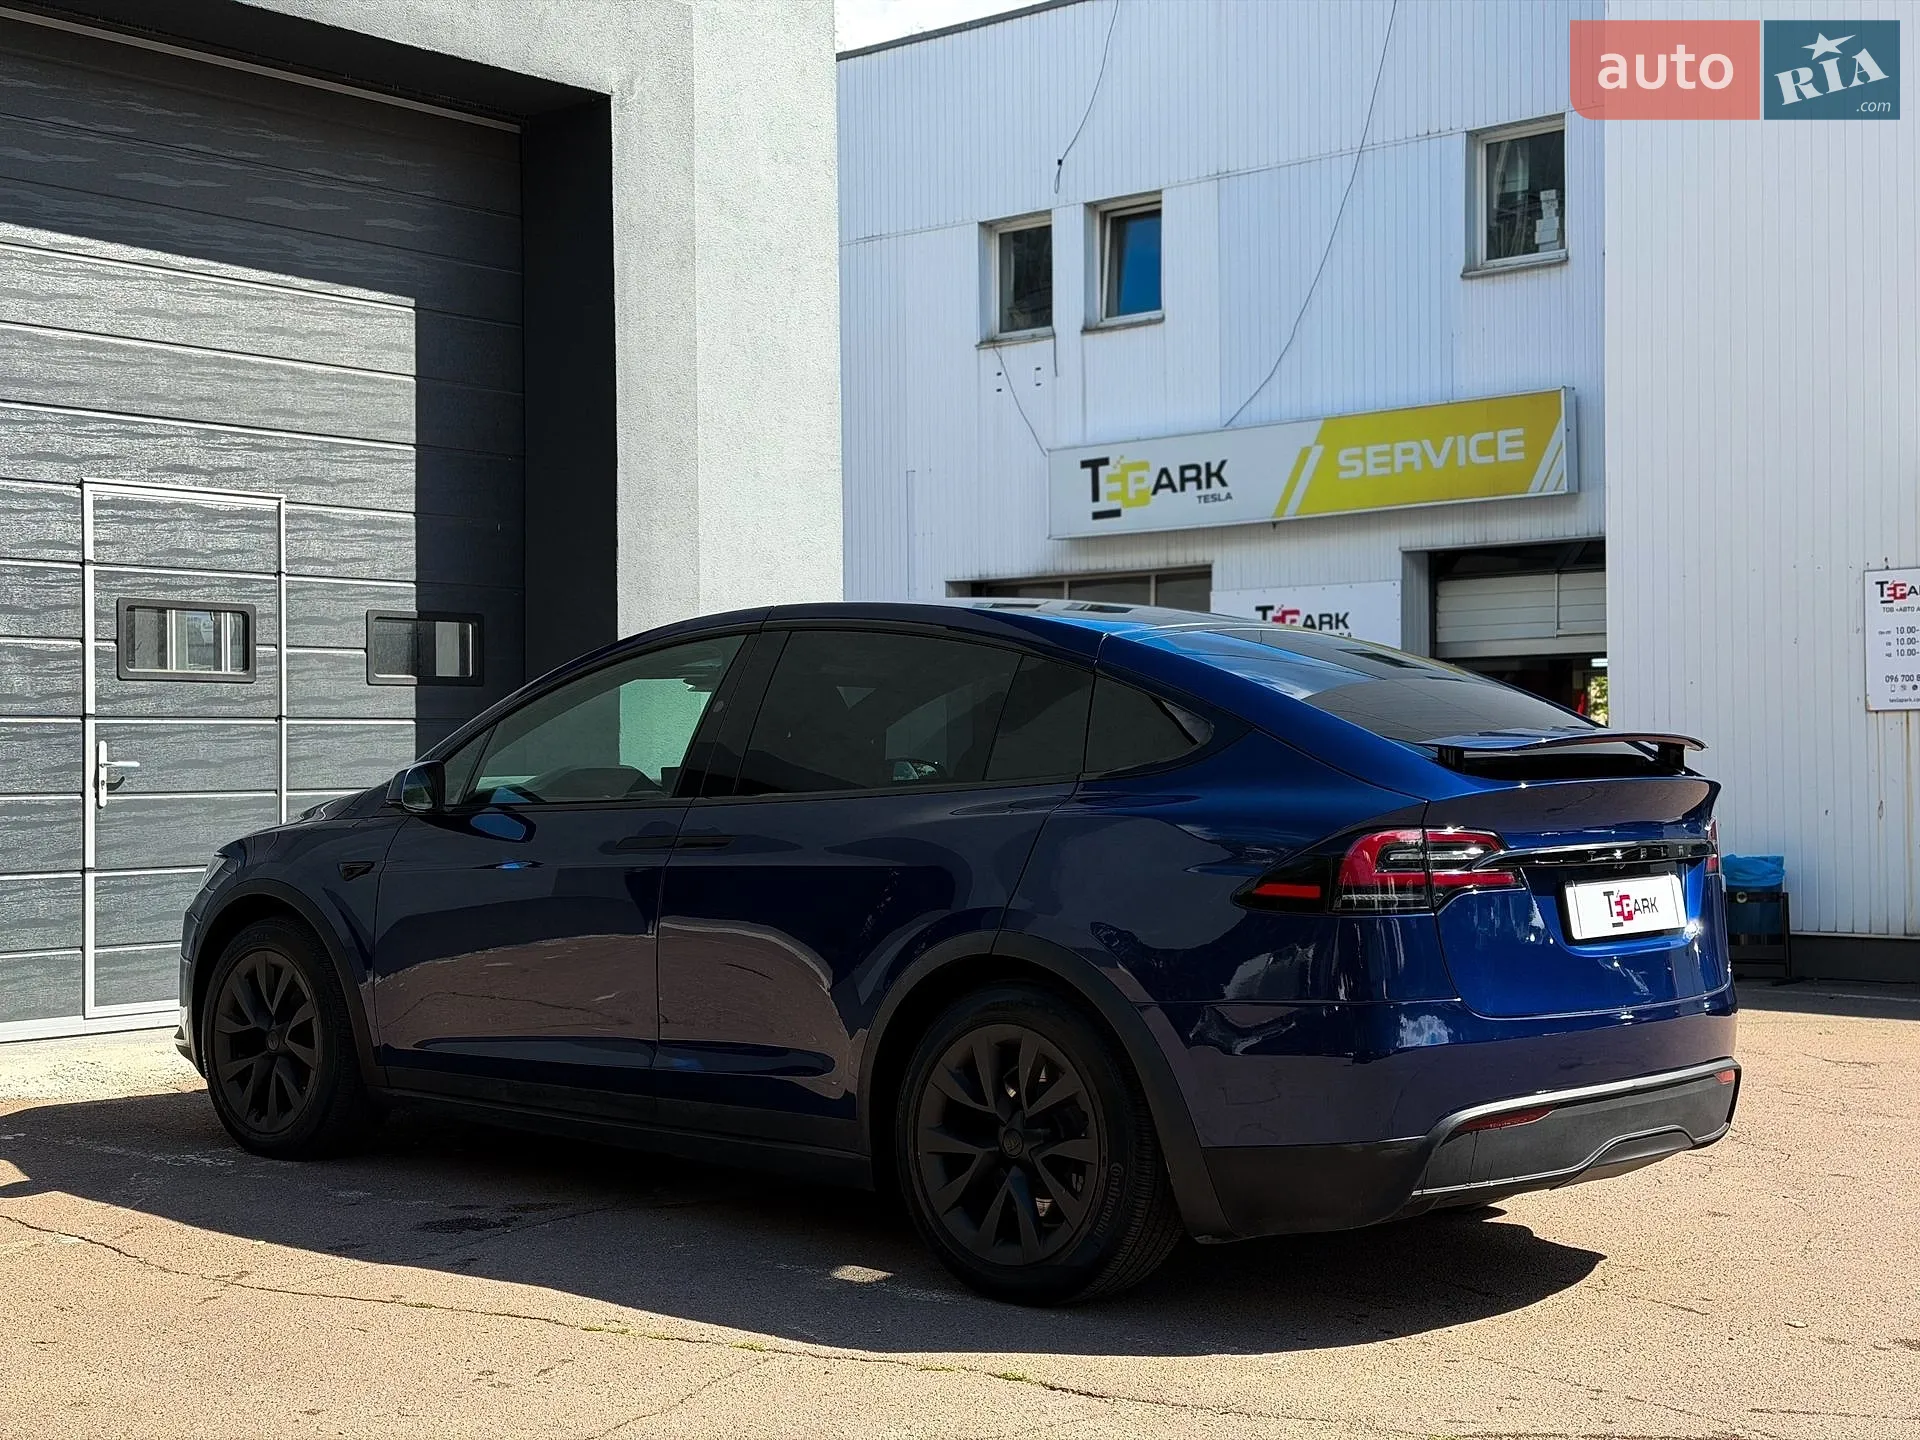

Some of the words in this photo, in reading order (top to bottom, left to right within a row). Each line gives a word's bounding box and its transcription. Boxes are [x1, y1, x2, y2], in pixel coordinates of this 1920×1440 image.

[1337, 427, 1525, 479] SERVICE
[1196, 492, 1233, 504] TESLA
[1885, 675, 1899, 683] 096
[1901, 674, 1914, 682] 700
